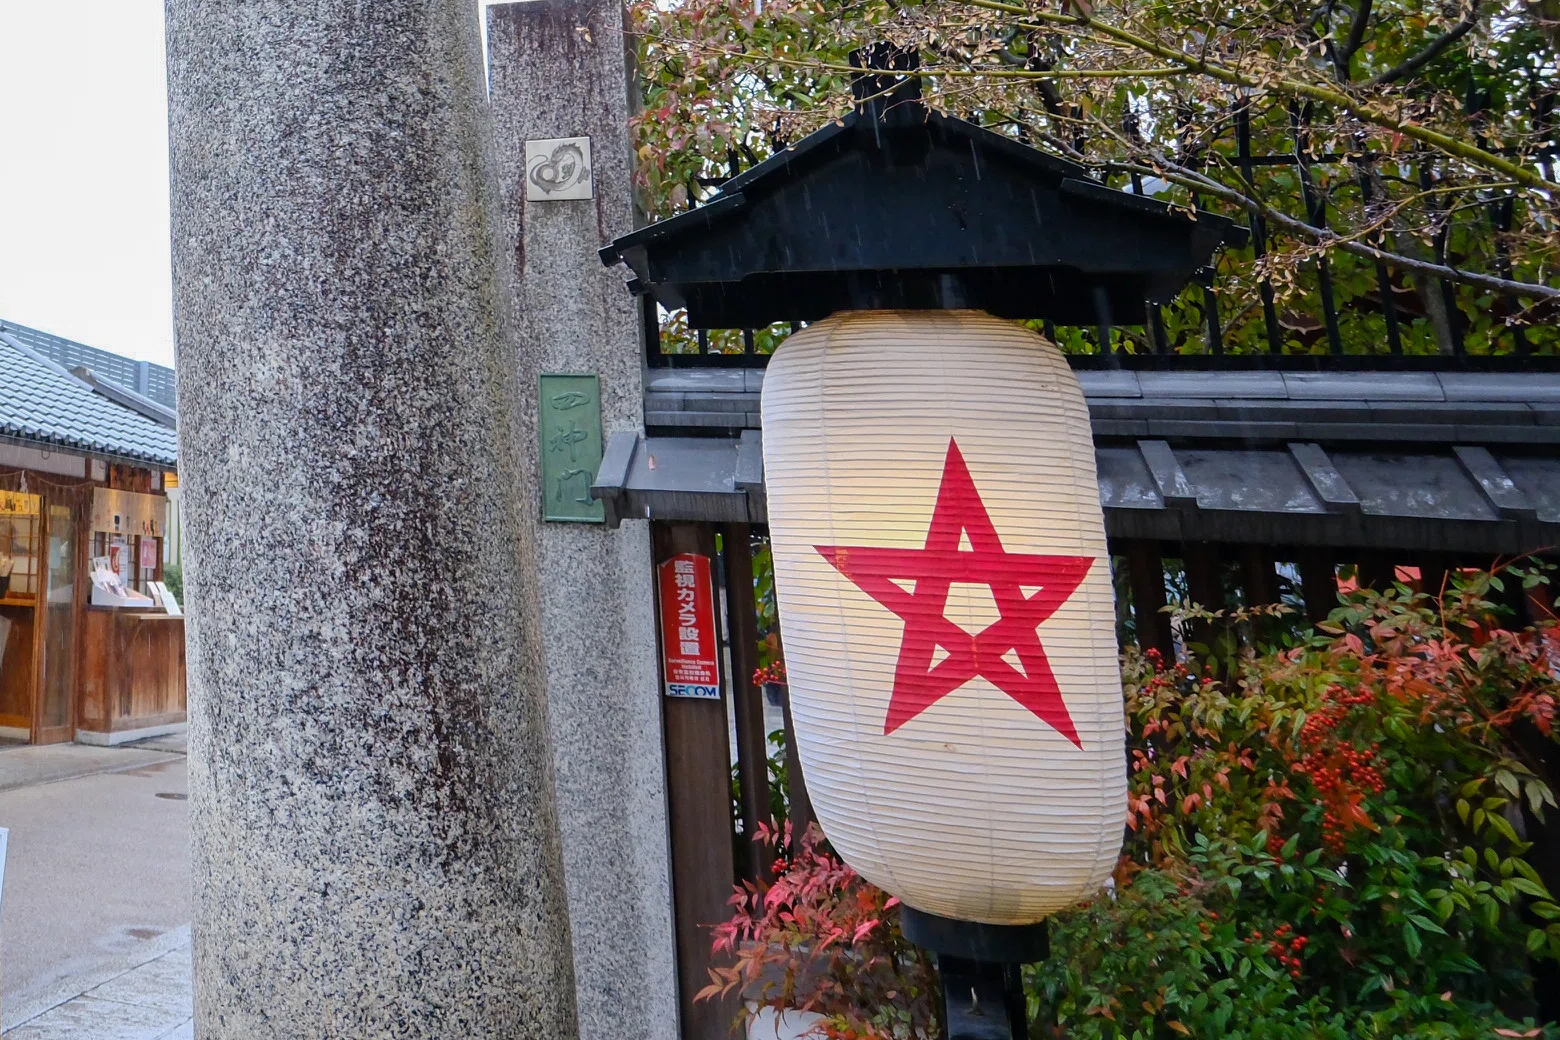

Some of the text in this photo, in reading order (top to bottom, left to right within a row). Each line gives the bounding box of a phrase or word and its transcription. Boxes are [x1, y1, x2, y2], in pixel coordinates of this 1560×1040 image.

[673, 559, 701, 656] 監視カメラ設置
[669, 684, 716, 697] SECOM
